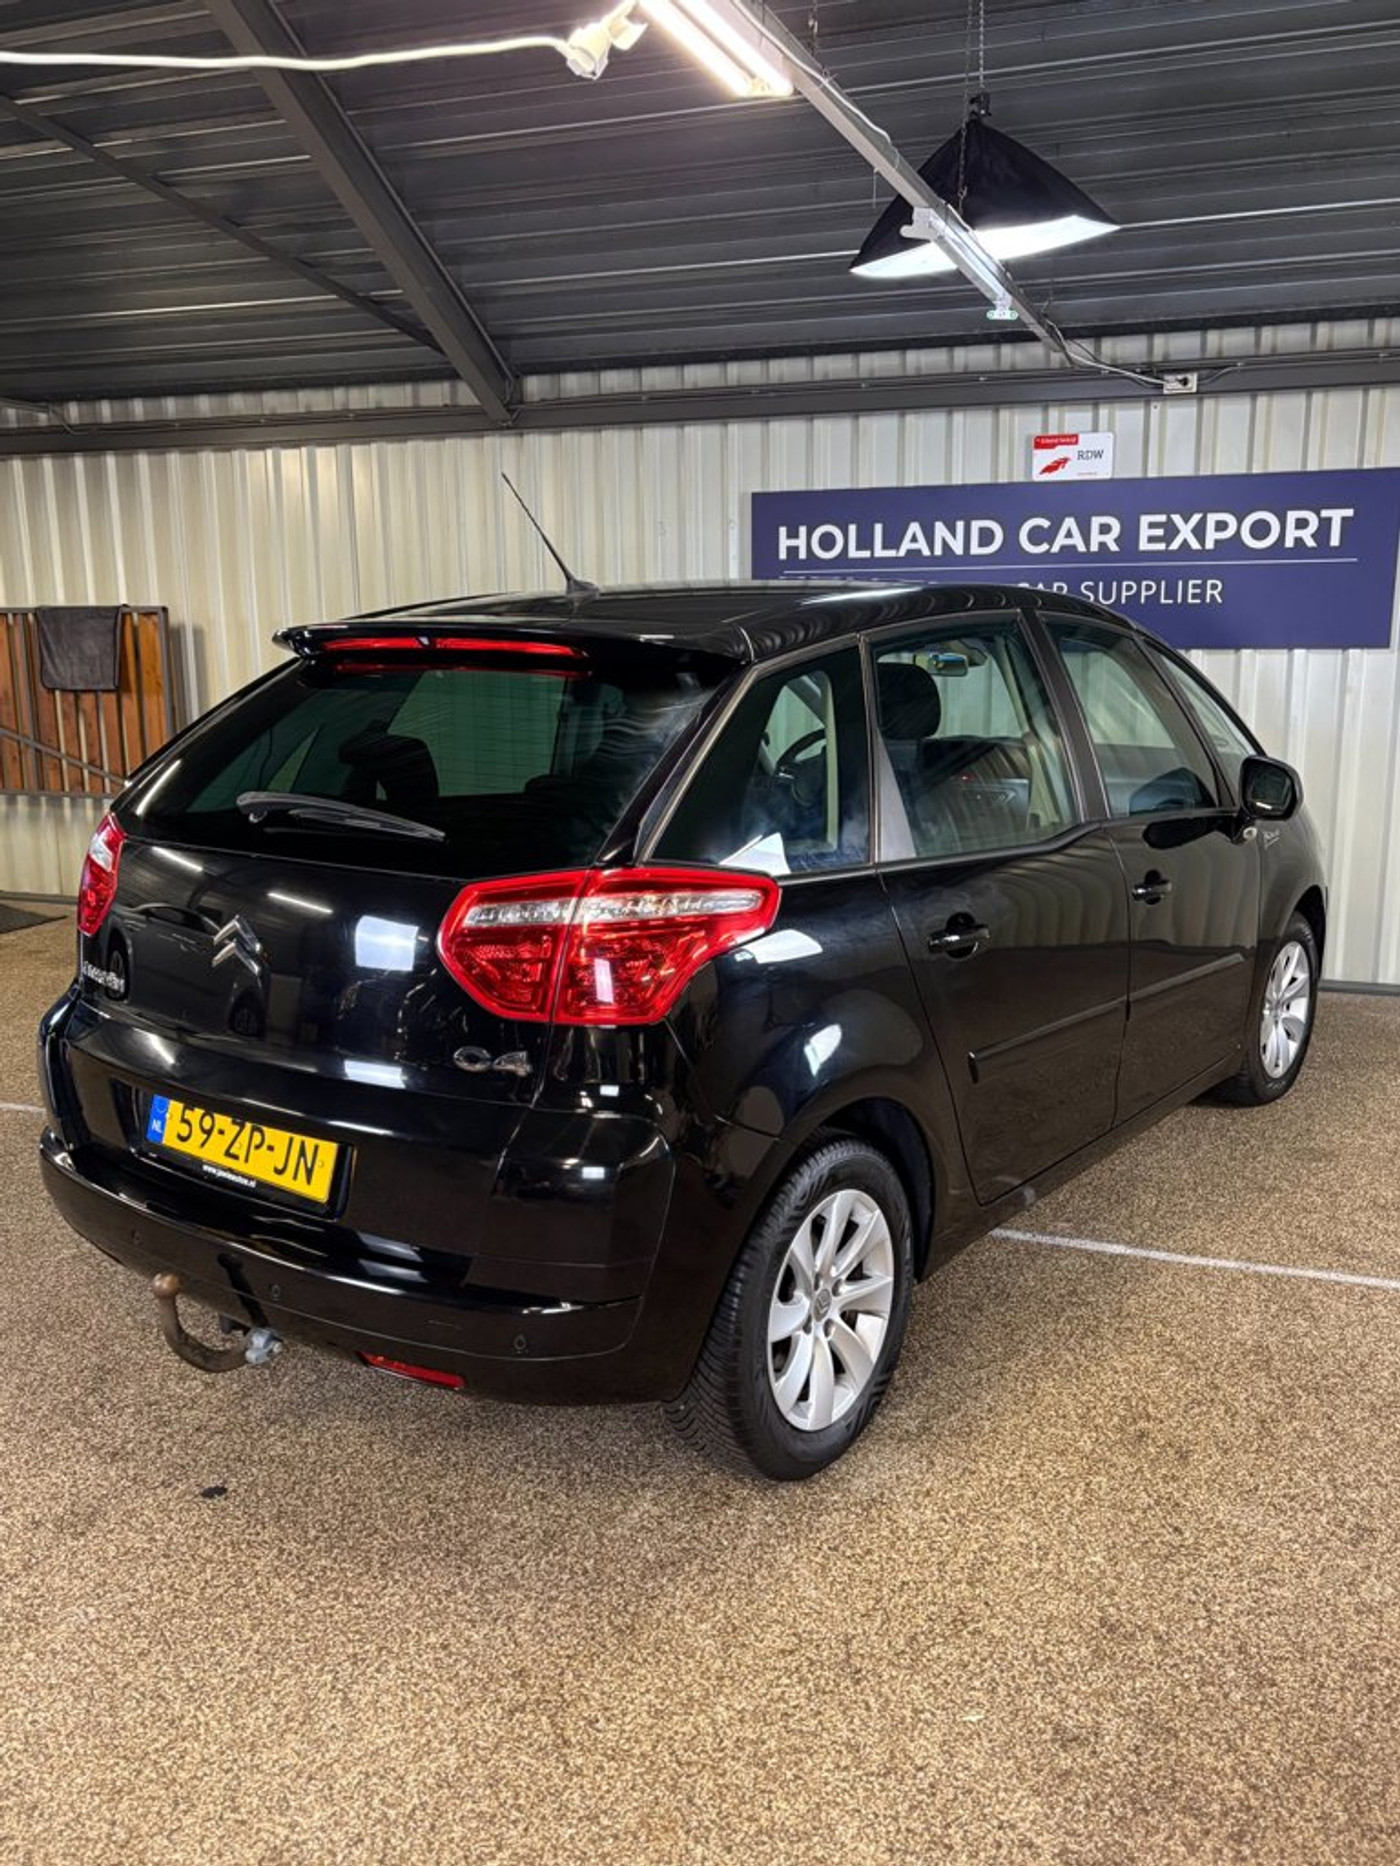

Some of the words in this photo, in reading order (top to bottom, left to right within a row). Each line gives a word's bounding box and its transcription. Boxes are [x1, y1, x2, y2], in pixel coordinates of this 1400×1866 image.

[1077, 449, 1104, 461] RDW
[778, 519, 1004, 560] HOLLAND
[1018, 515, 1122, 554] CAR
[1138, 508, 1355, 551] EXPORT
[1080, 579, 1223, 605] SUPPLIER
[151, 1118, 162, 1133] NL
[176, 1101, 320, 1186] 59-ZP-JN
